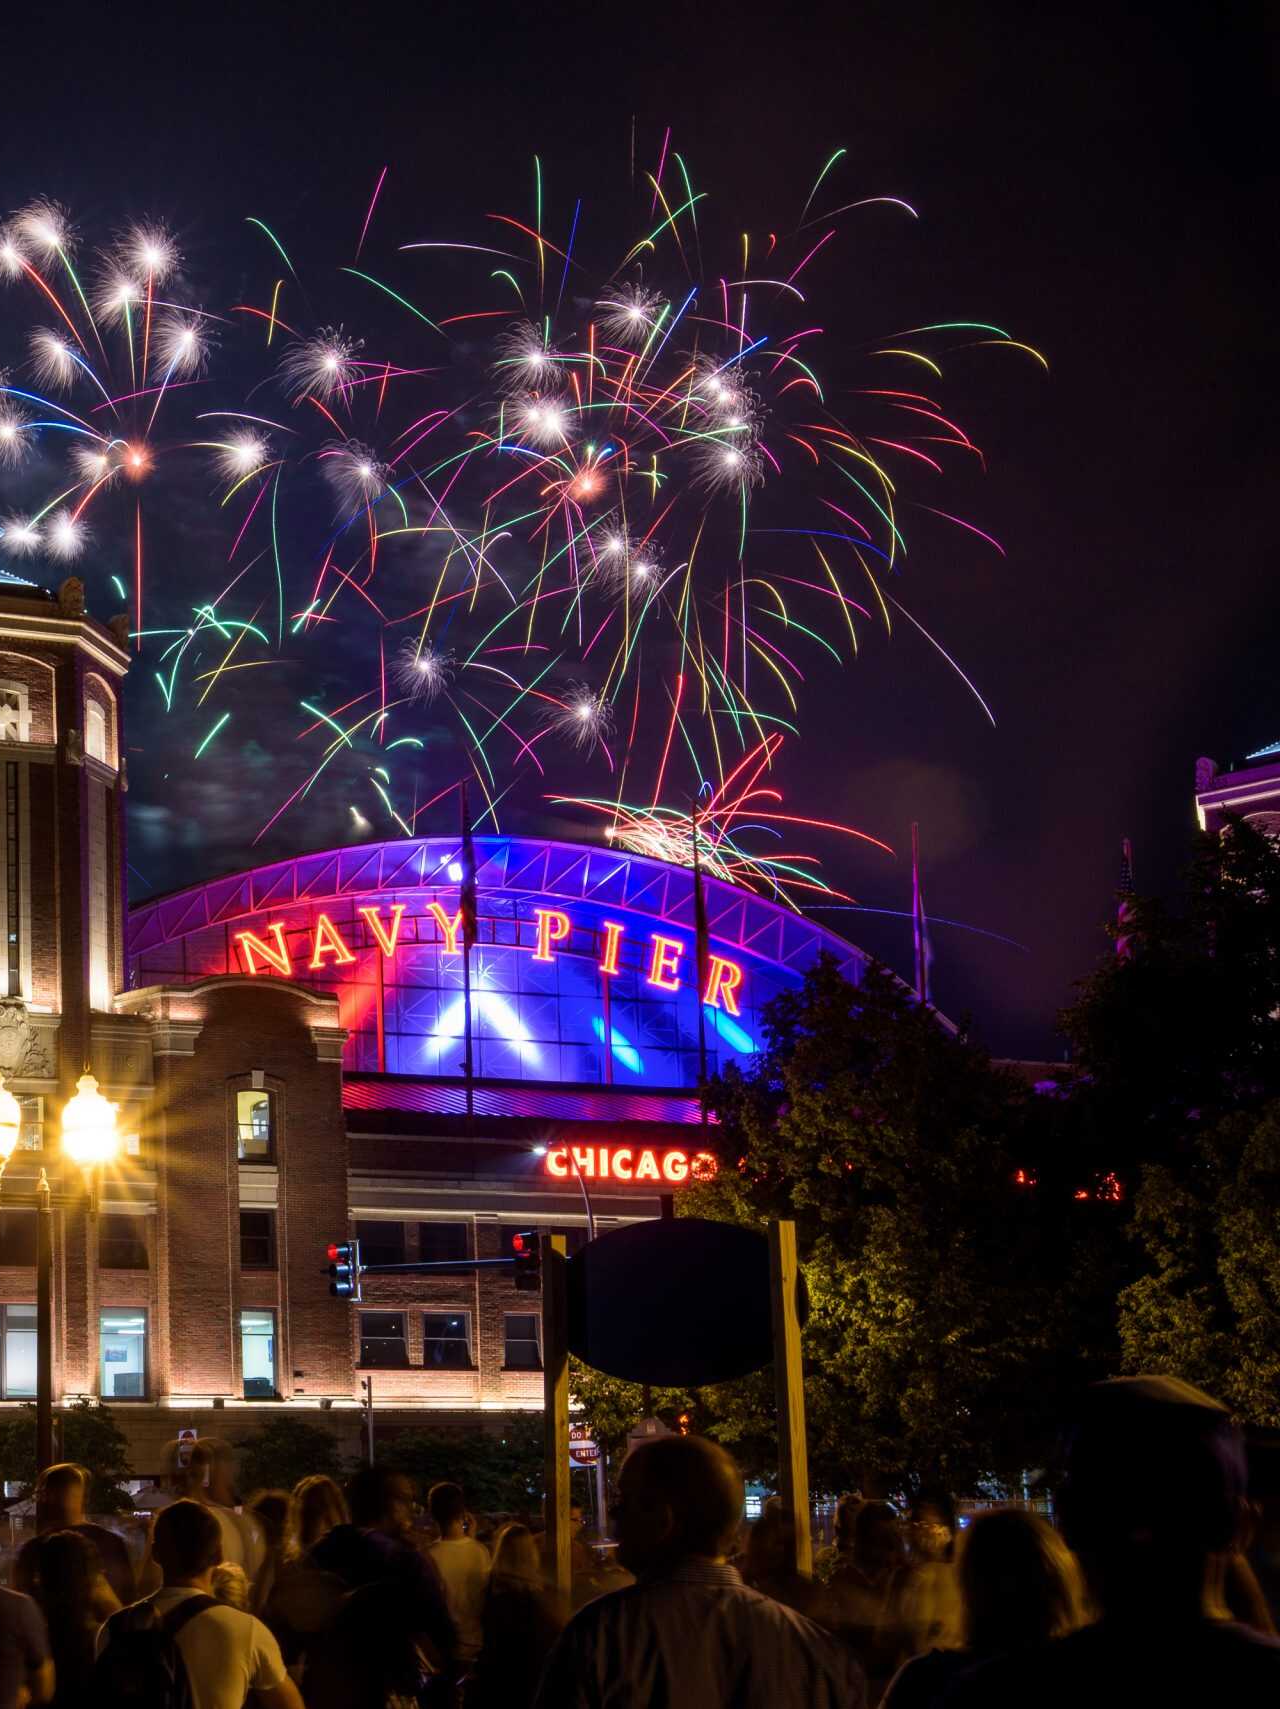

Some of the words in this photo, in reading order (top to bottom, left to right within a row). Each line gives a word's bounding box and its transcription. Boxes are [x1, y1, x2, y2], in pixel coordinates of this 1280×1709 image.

[235, 902, 464, 976] NAVY
[532, 908, 742, 1017] PIER
[546, 1146, 719, 1182] CHICAGO
[571, 1431, 582, 1440] DO
